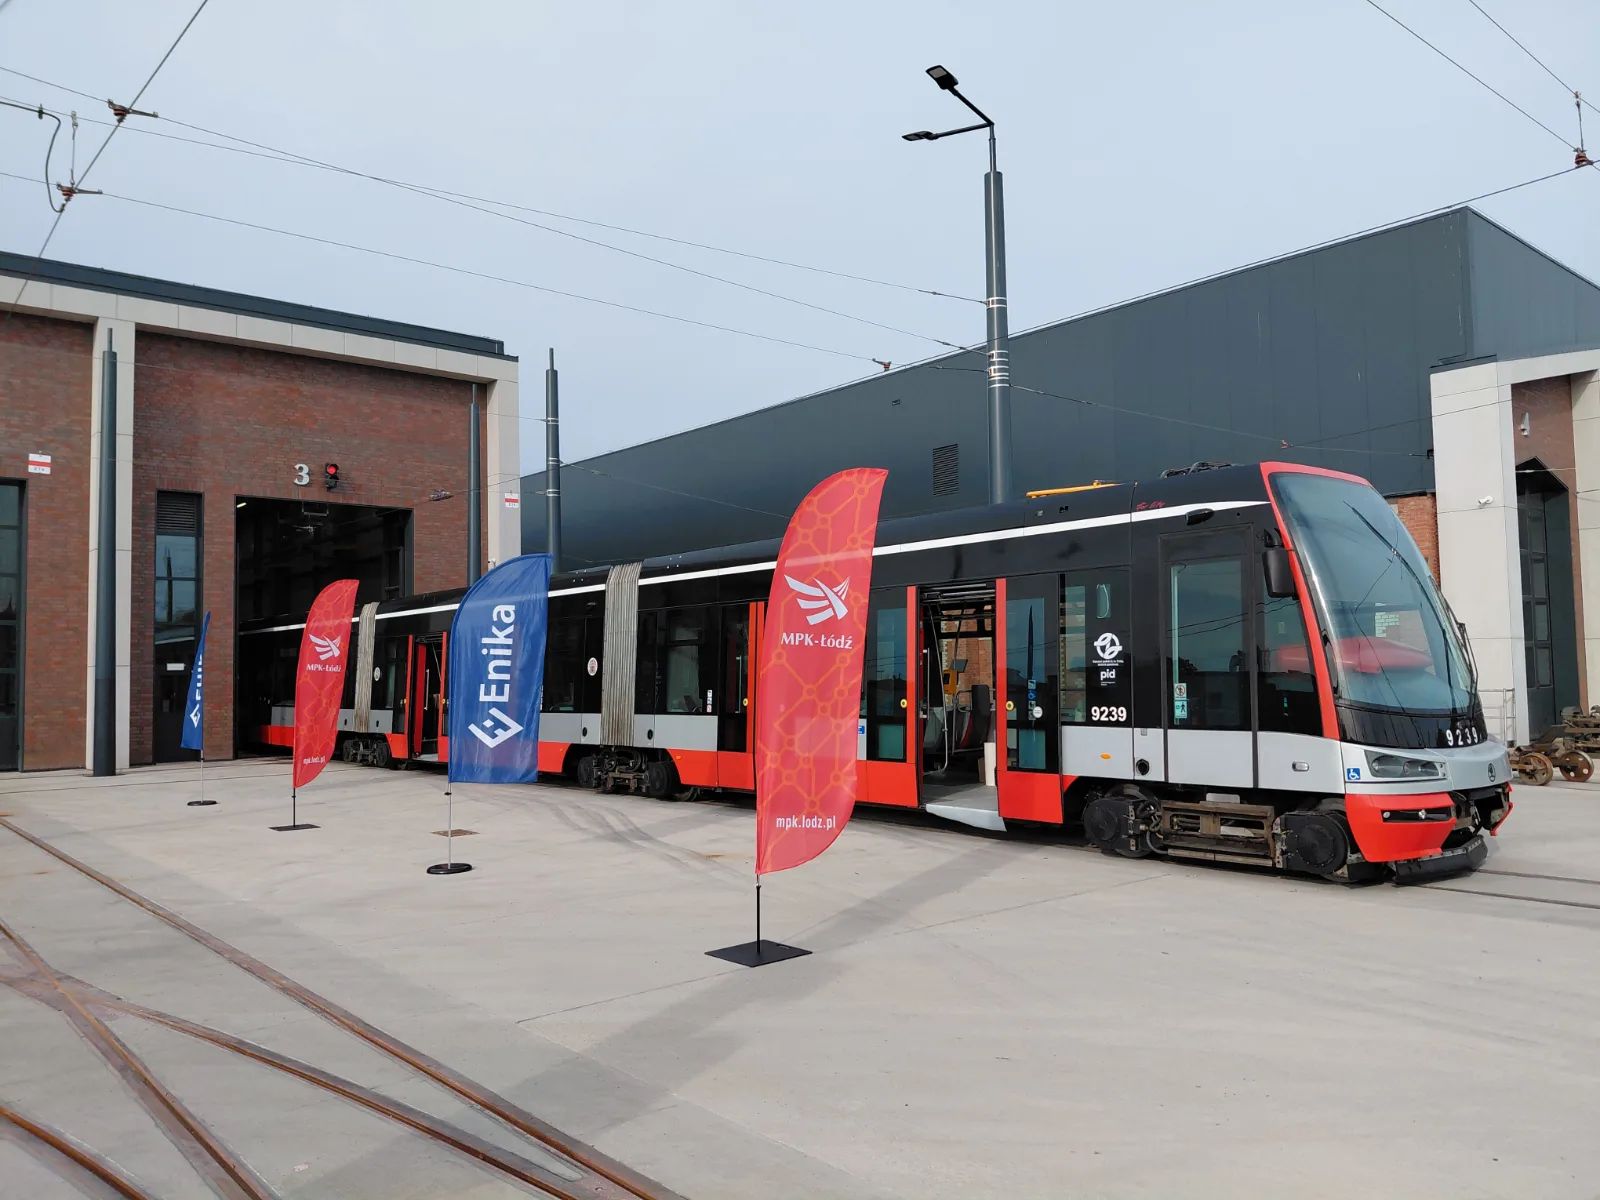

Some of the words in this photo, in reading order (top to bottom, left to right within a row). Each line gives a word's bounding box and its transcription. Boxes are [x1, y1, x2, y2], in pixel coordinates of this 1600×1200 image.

[294, 463, 310, 485] 3
[780, 632, 853, 649] MPK-Łódź
[479, 604, 516, 703] Enika
[1100, 668, 1116, 680] pid
[1091, 706, 1127, 721] 9239
[1446, 726, 1479, 746] 9239
[776, 815, 836, 830] mpk.lodz.pl
